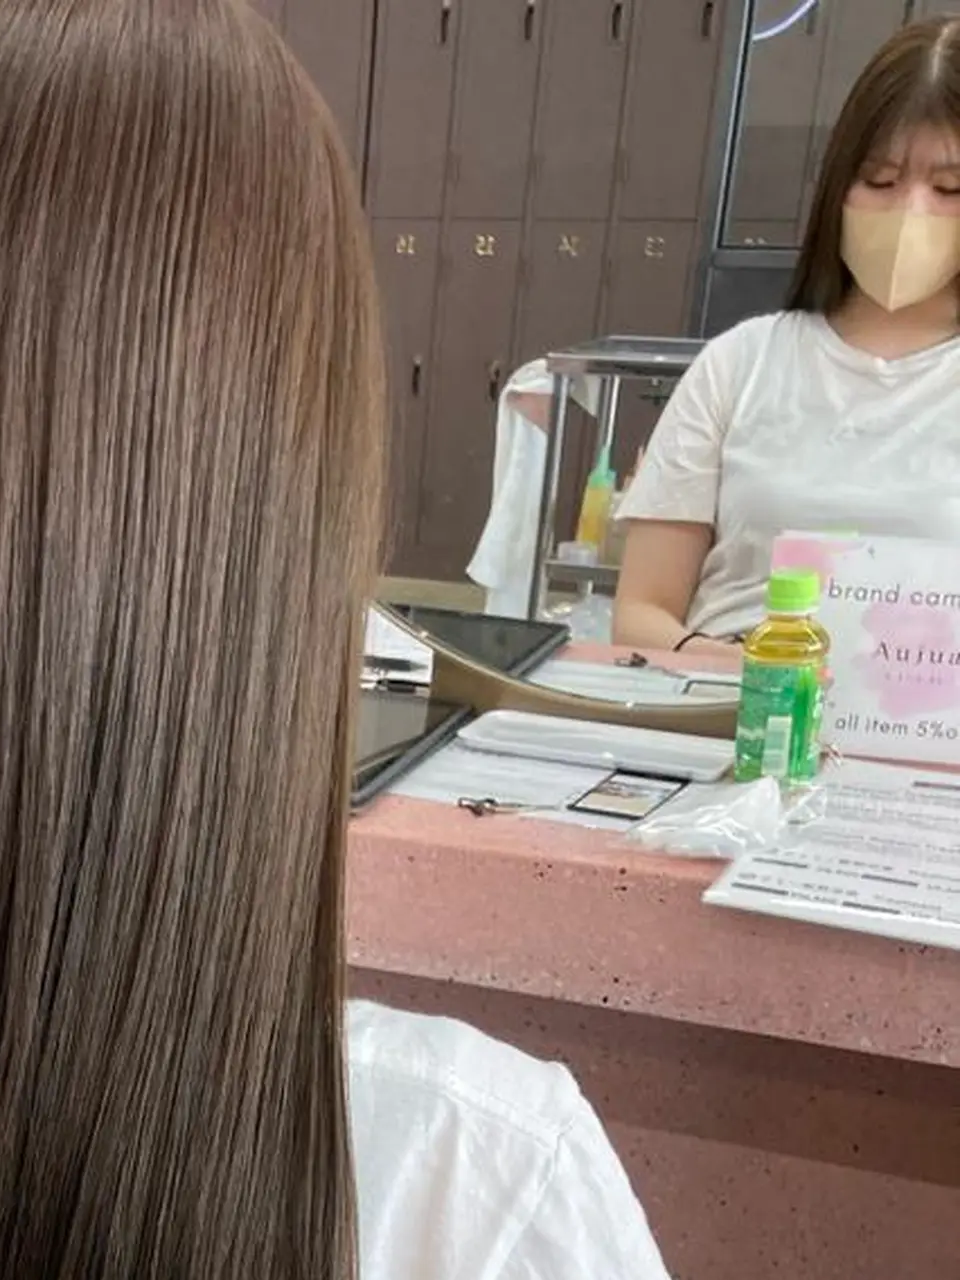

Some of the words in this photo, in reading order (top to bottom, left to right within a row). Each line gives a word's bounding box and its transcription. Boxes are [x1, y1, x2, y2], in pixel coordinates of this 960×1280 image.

[828, 577, 901, 605] brand
[835, 713, 859, 732] all
[865, 716, 908, 736] item
